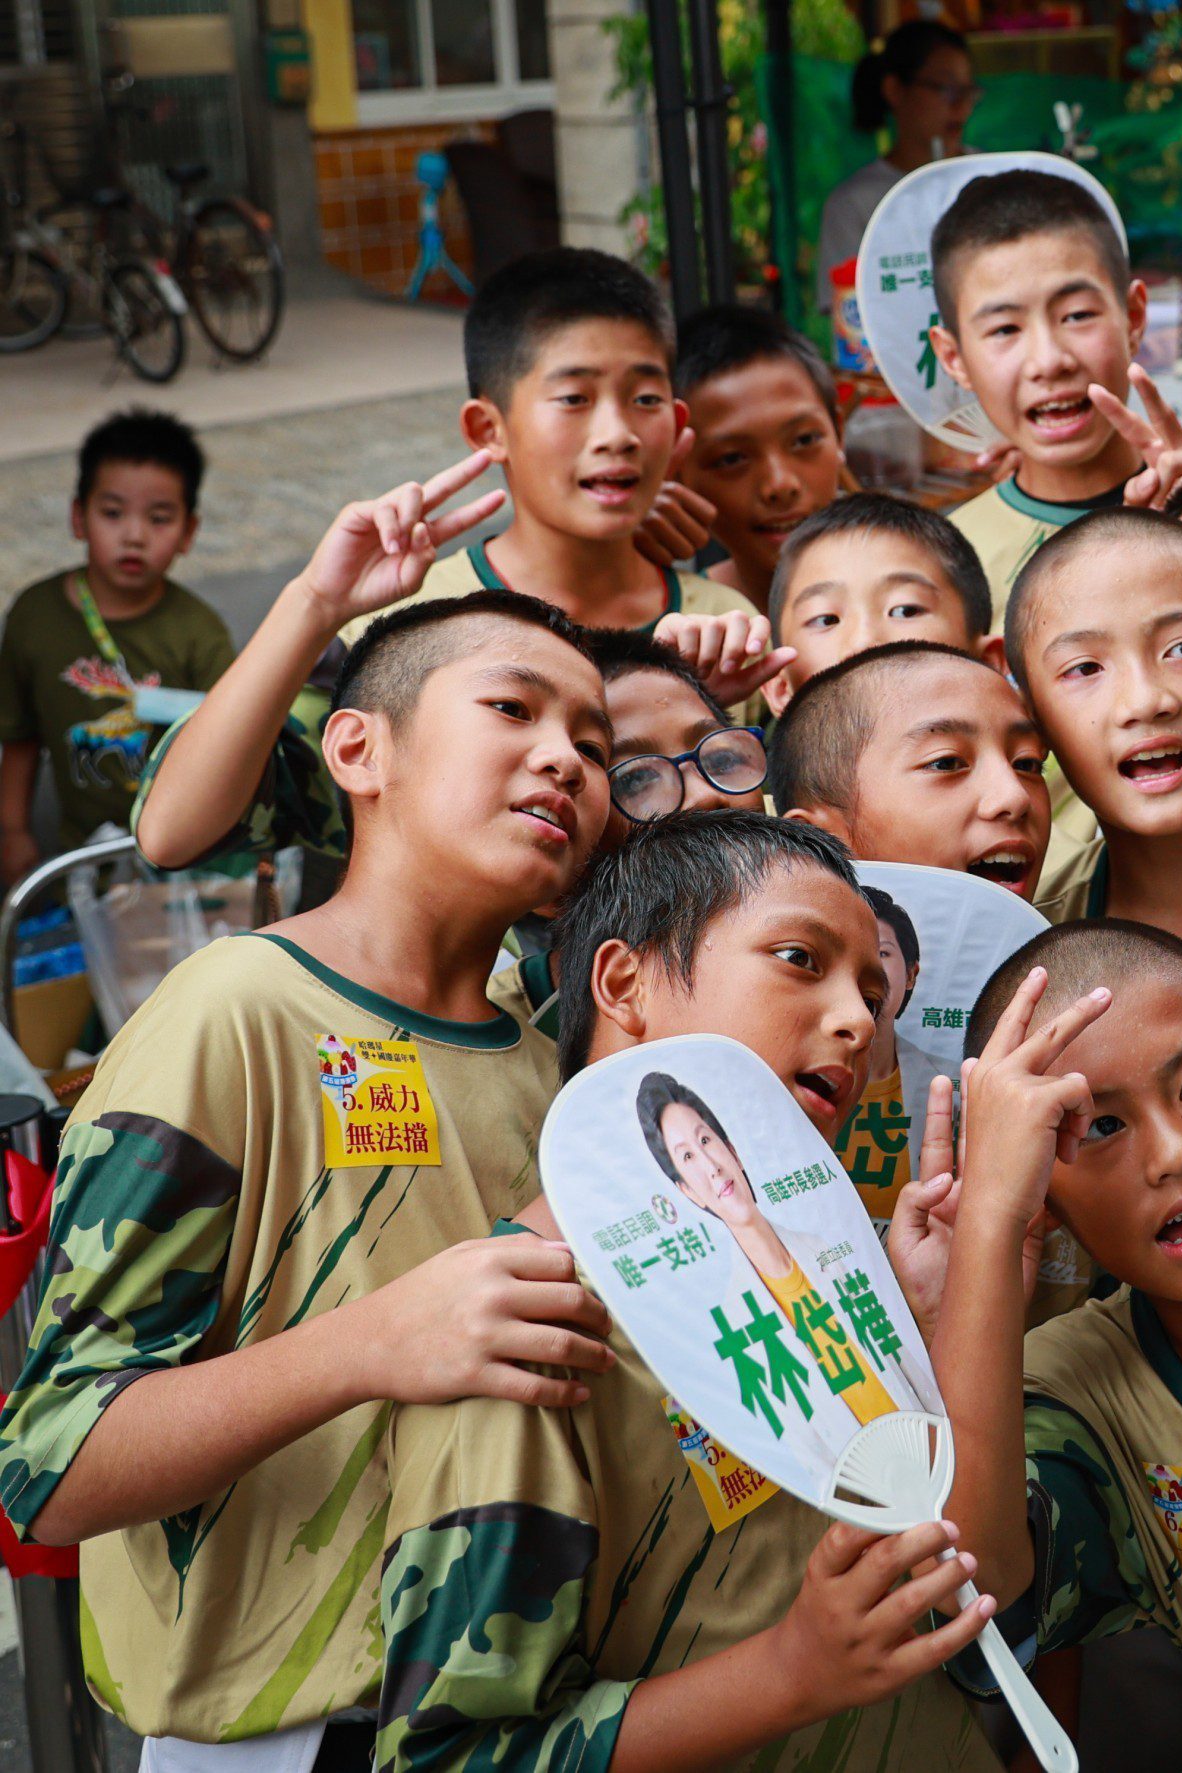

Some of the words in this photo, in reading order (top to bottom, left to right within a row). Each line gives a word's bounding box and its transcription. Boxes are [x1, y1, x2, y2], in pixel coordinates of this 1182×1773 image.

[345, 1121, 429, 1155] 無法擋
[761, 1160, 838, 1206] 高雄市長參選人
[592, 1210, 661, 1252] 電話民調
[709, 1267, 904, 1441] 林岱樺
